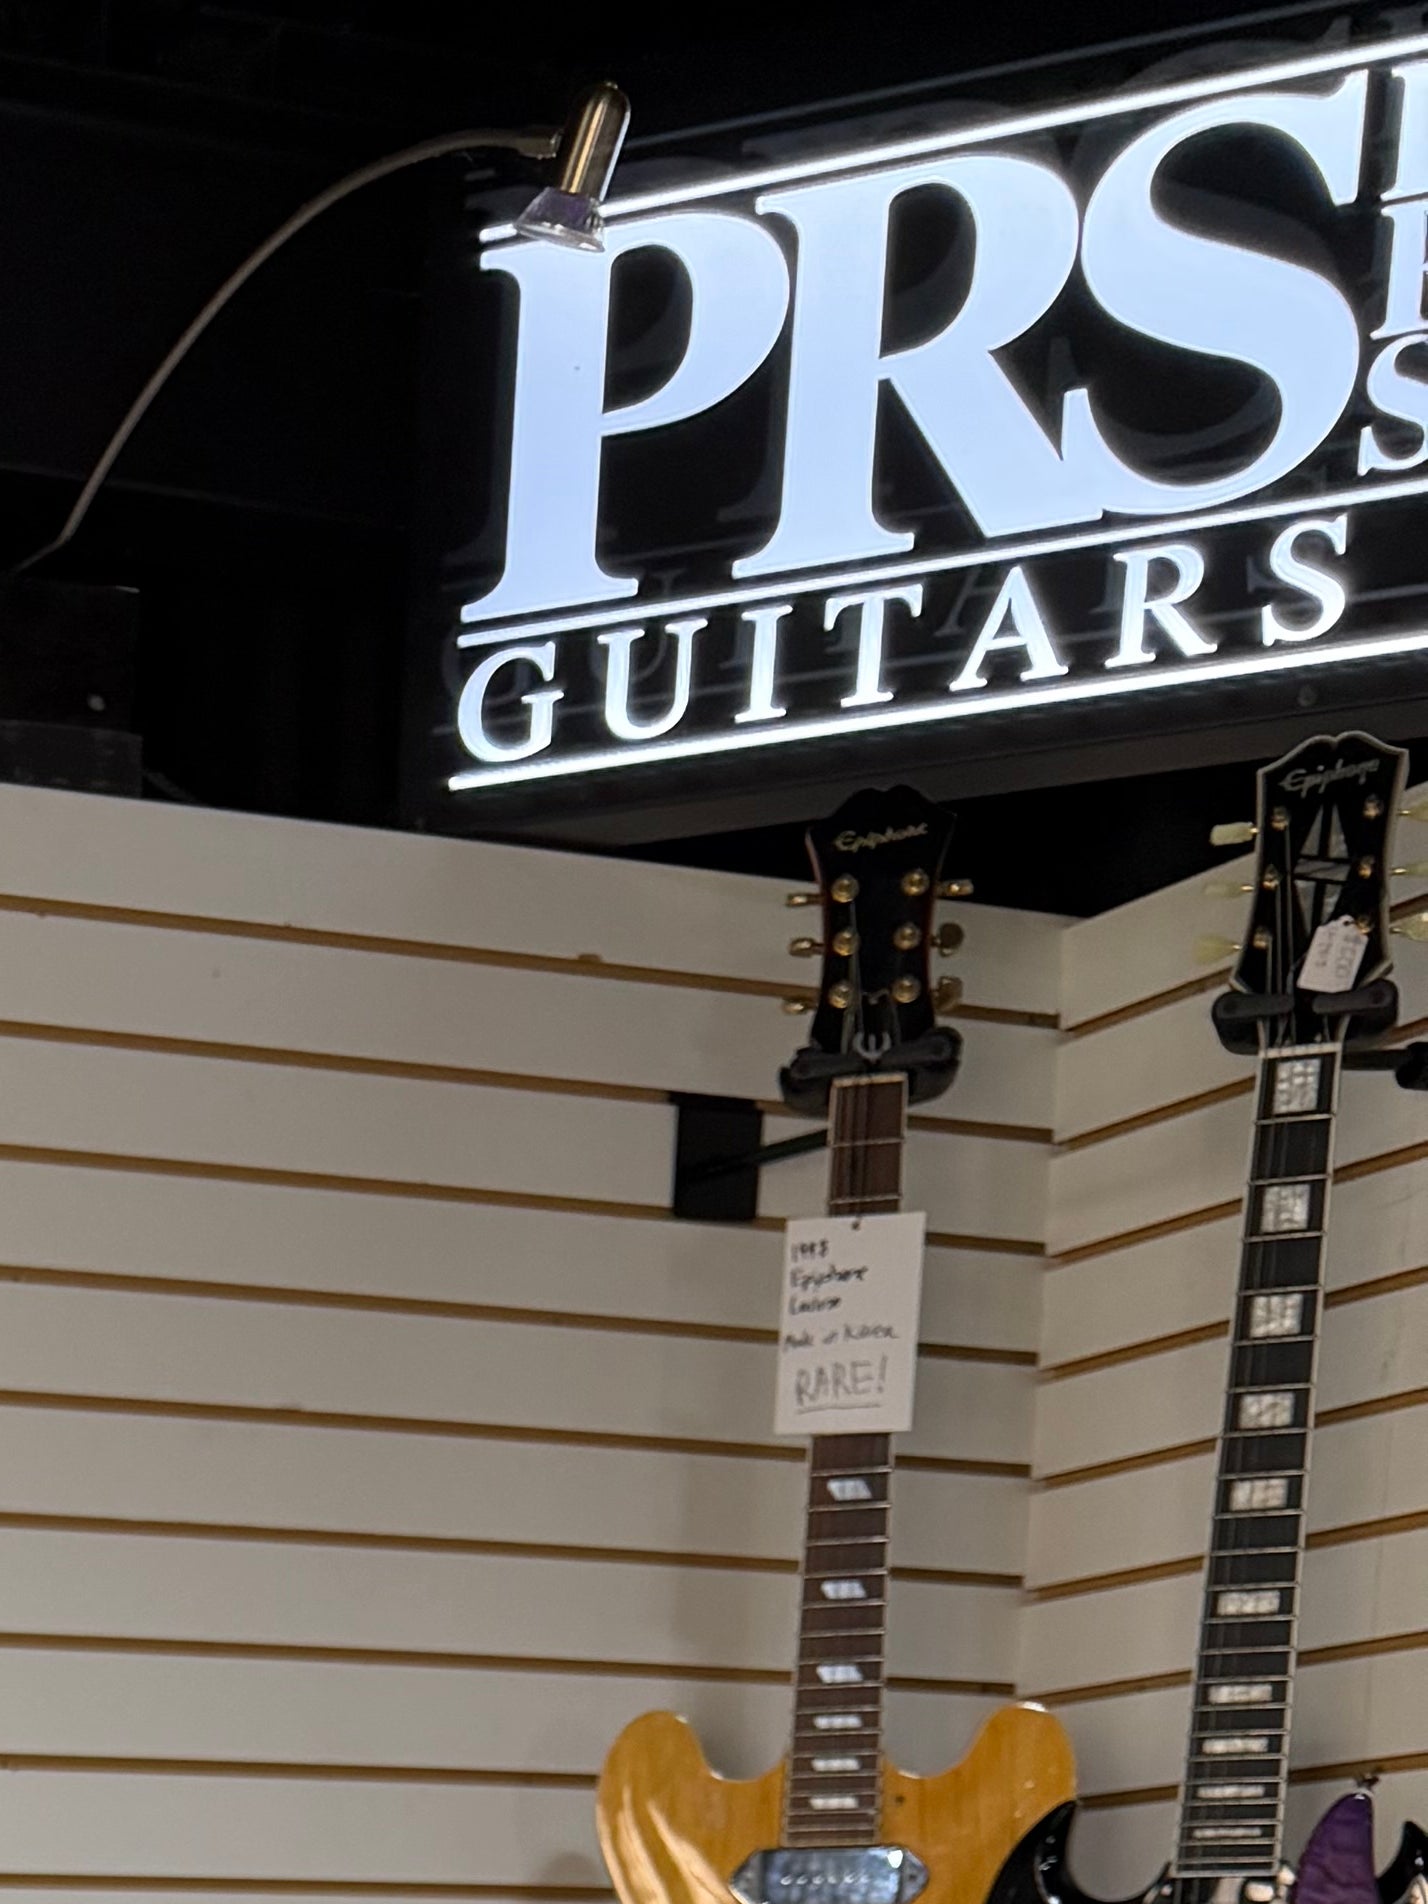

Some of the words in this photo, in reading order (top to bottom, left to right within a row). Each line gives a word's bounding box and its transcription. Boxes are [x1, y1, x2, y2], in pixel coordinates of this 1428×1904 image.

[460, 68, 1369, 622] PRS
[457, 514, 1349, 764] GUITARS
[1278, 758, 1381, 799] Epiphone
[796, 1353, 888, 1406] RARE!
